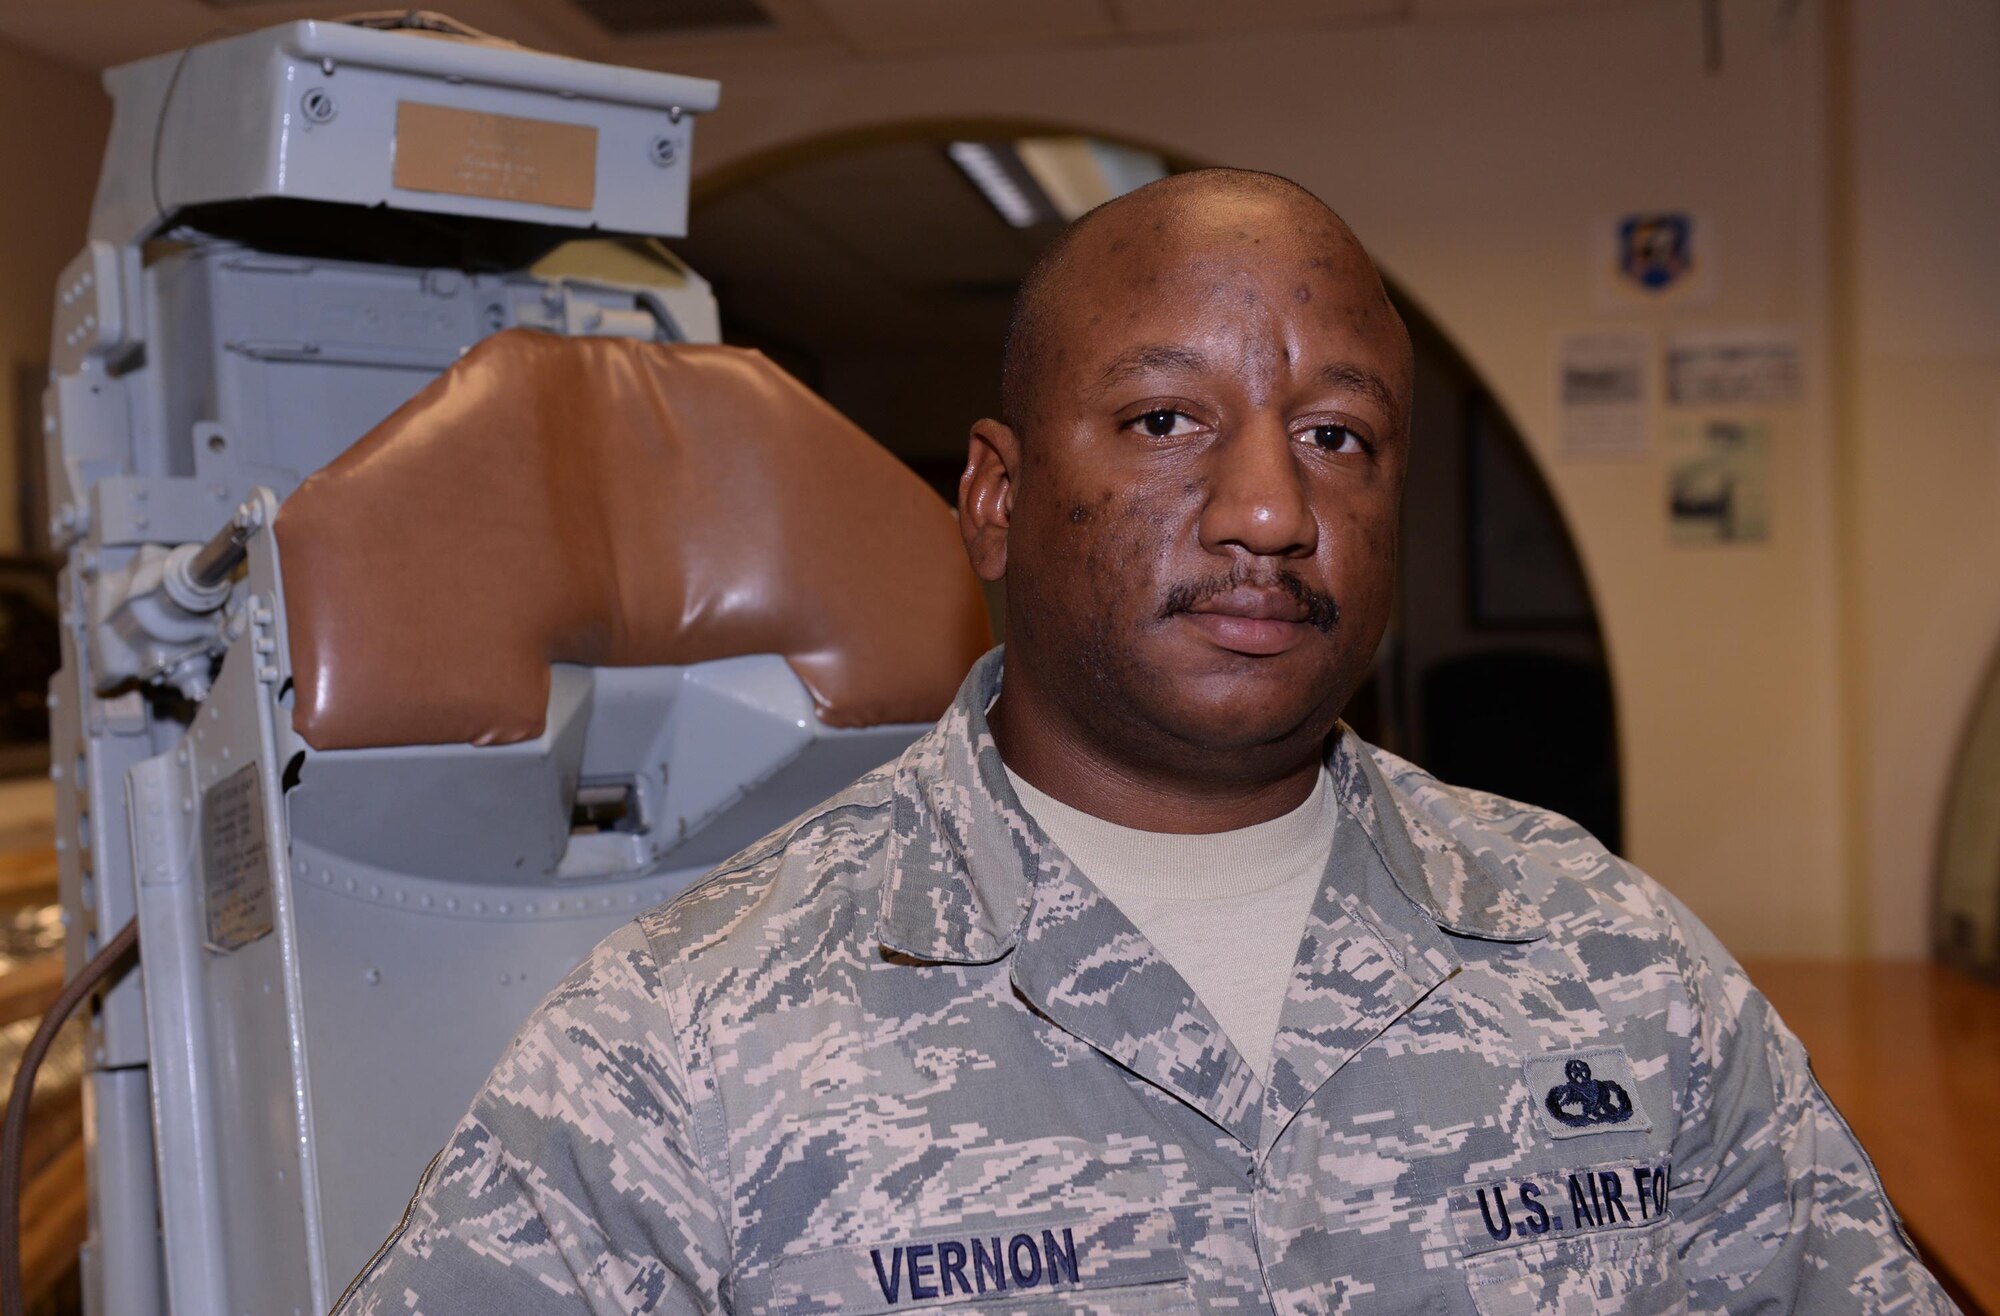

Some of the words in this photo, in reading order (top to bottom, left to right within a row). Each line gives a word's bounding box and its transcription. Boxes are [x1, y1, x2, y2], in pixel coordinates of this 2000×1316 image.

[1476, 1182, 1563, 1241] U.S.
[1568, 1171, 1631, 1228] AIR
[870, 1228, 1080, 1305] VERNON
